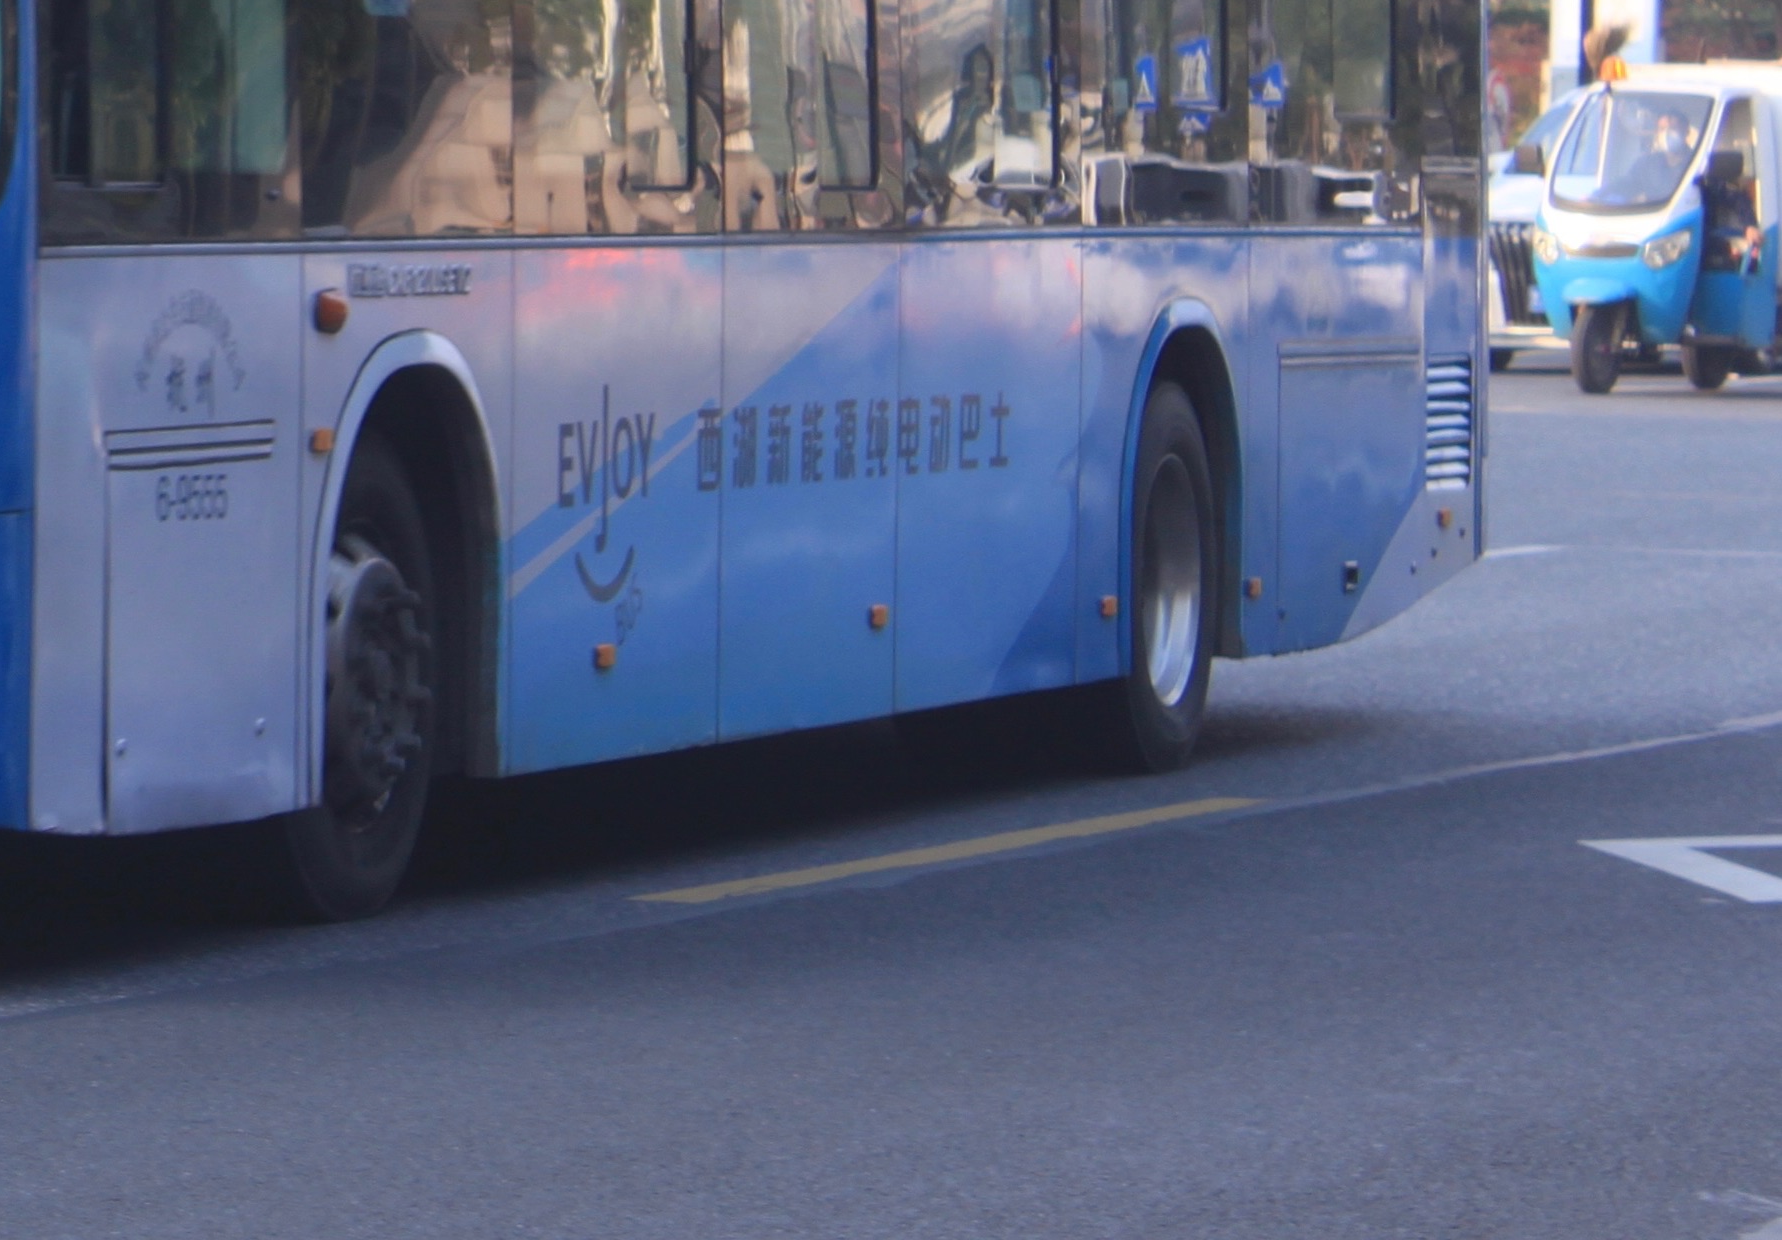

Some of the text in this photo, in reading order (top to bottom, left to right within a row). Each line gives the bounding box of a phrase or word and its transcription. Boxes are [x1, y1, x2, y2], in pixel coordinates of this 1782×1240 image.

[697, 390, 1011, 492] 西湖新能源纯电动巴士
[155, 474, 229, 522] 6-9555
